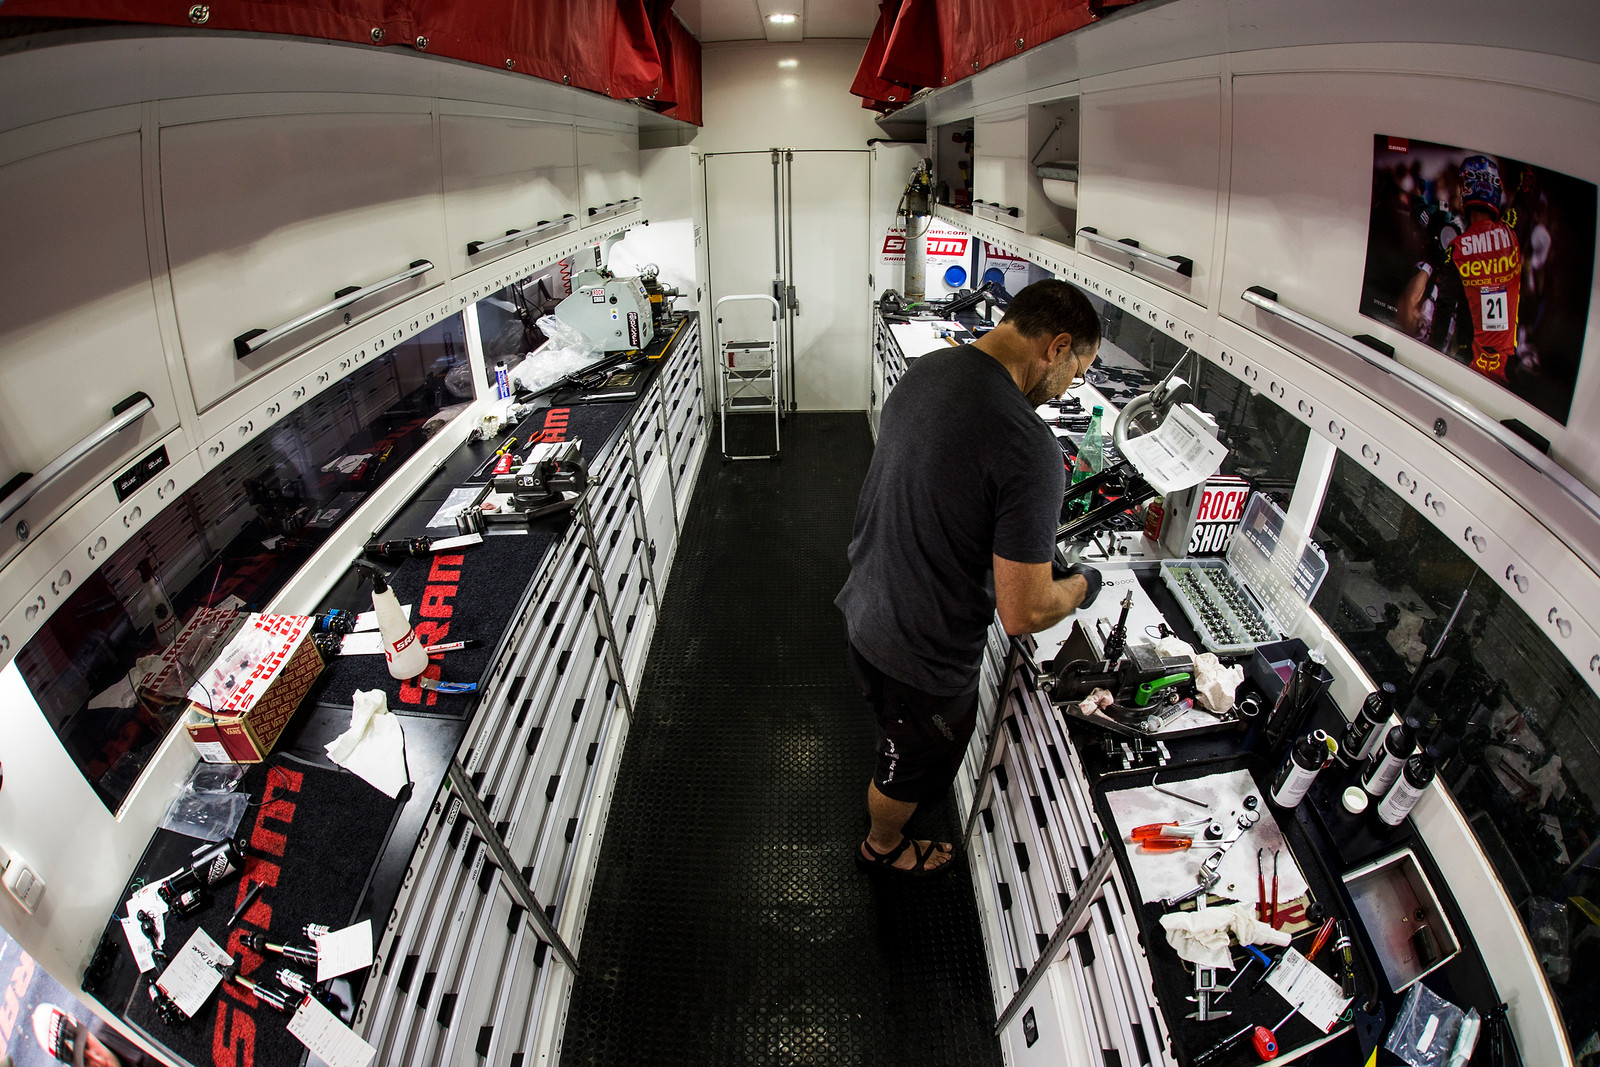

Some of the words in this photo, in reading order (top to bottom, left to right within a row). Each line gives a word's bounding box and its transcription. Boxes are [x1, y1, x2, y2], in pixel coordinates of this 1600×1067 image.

[886, 240, 962, 253] SAM
[1461, 228, 1511, 256] SMITH
[1460, 246, 1519, 277] devinci
[1462, 277, 1492, 287] global
[1487, 298, 1503, 319] 21
[1197, 491, 1248, 520] ROCK
[1188, 524, 1240, 553] SHOX
